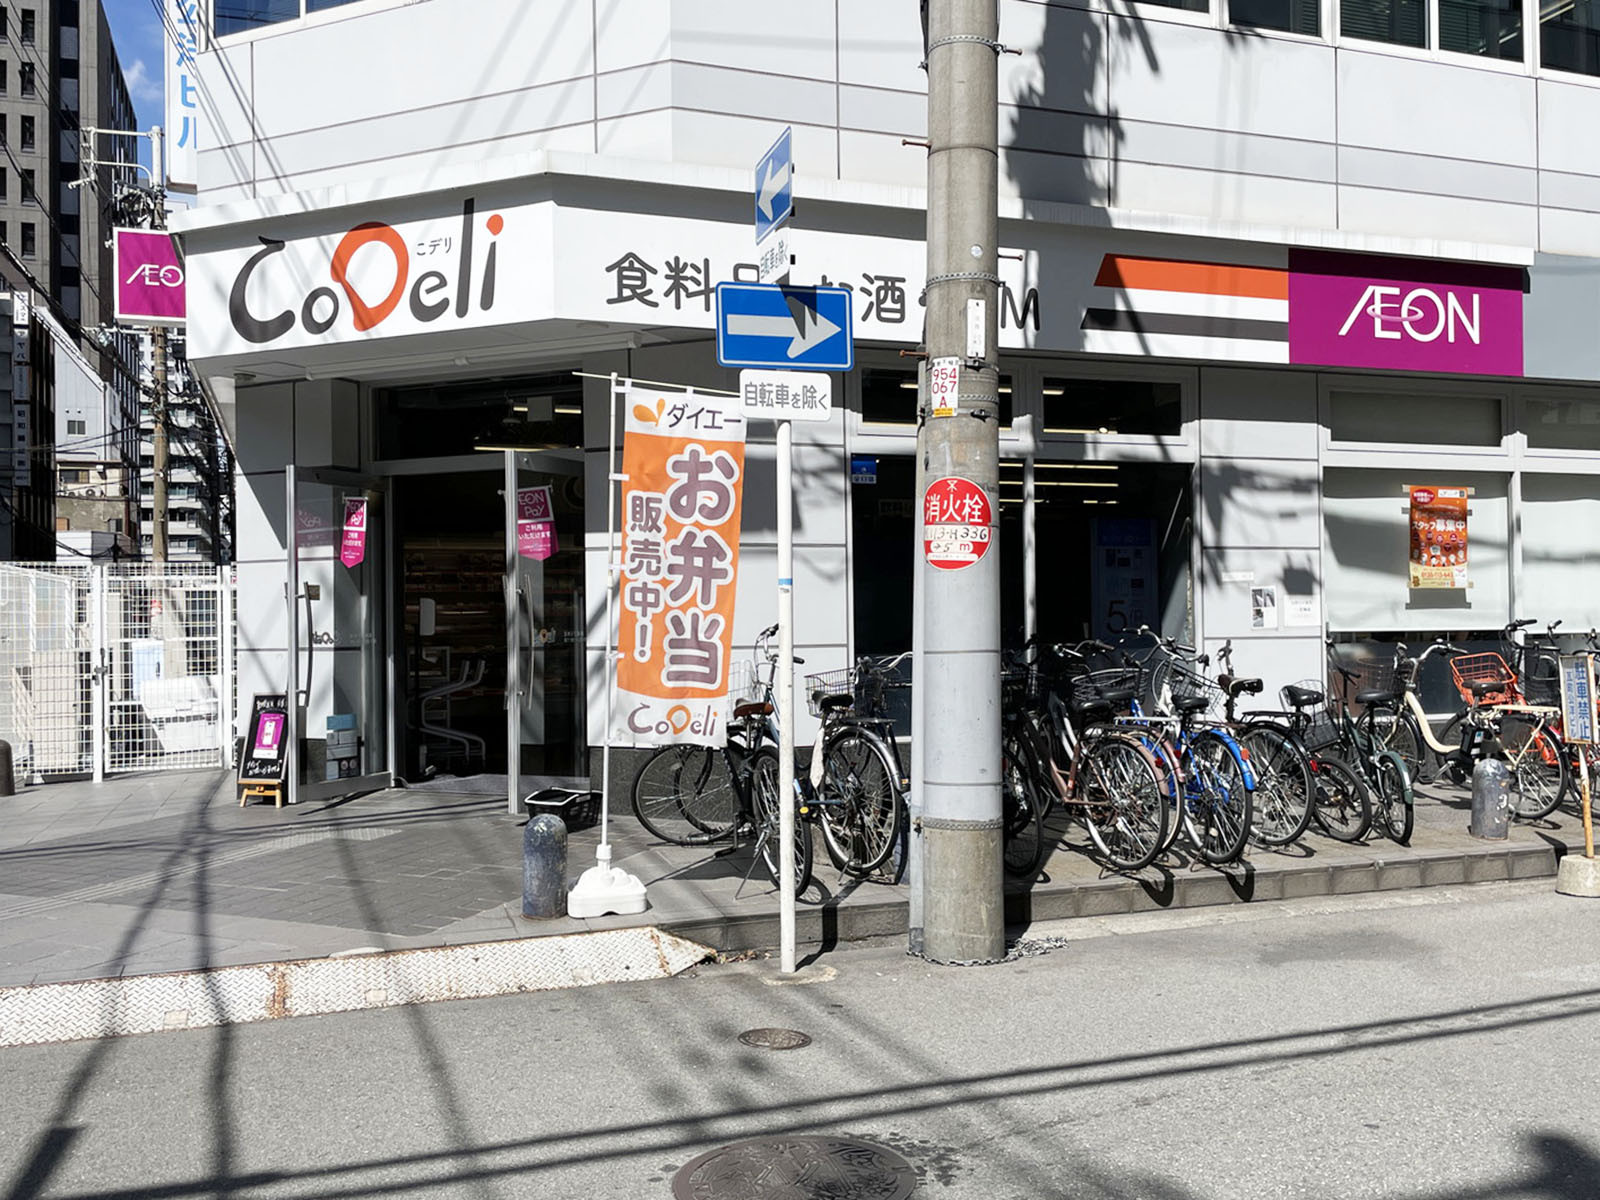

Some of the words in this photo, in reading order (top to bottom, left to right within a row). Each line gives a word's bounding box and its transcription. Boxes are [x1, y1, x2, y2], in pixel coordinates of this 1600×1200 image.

[416, 236, 452, 256] こデリ
[229, 197, 504, 344] CoDeli
[932, 367, 957, 381] 954
[932, 380, 957, 394] 067
[744, 381, 828, 410] 自転車を除く
[939, 395, 948, 408] A
[667, 403, 742, 429] ダイエー
[925, 493, 984, 523] 消火栓
[959, 543, 970, 551] m
[665, 447, 736, 687] お弁当
[1575, 662, 1591, 740] 駐車禁止
[628, 702, 718, 736] CoDeli
